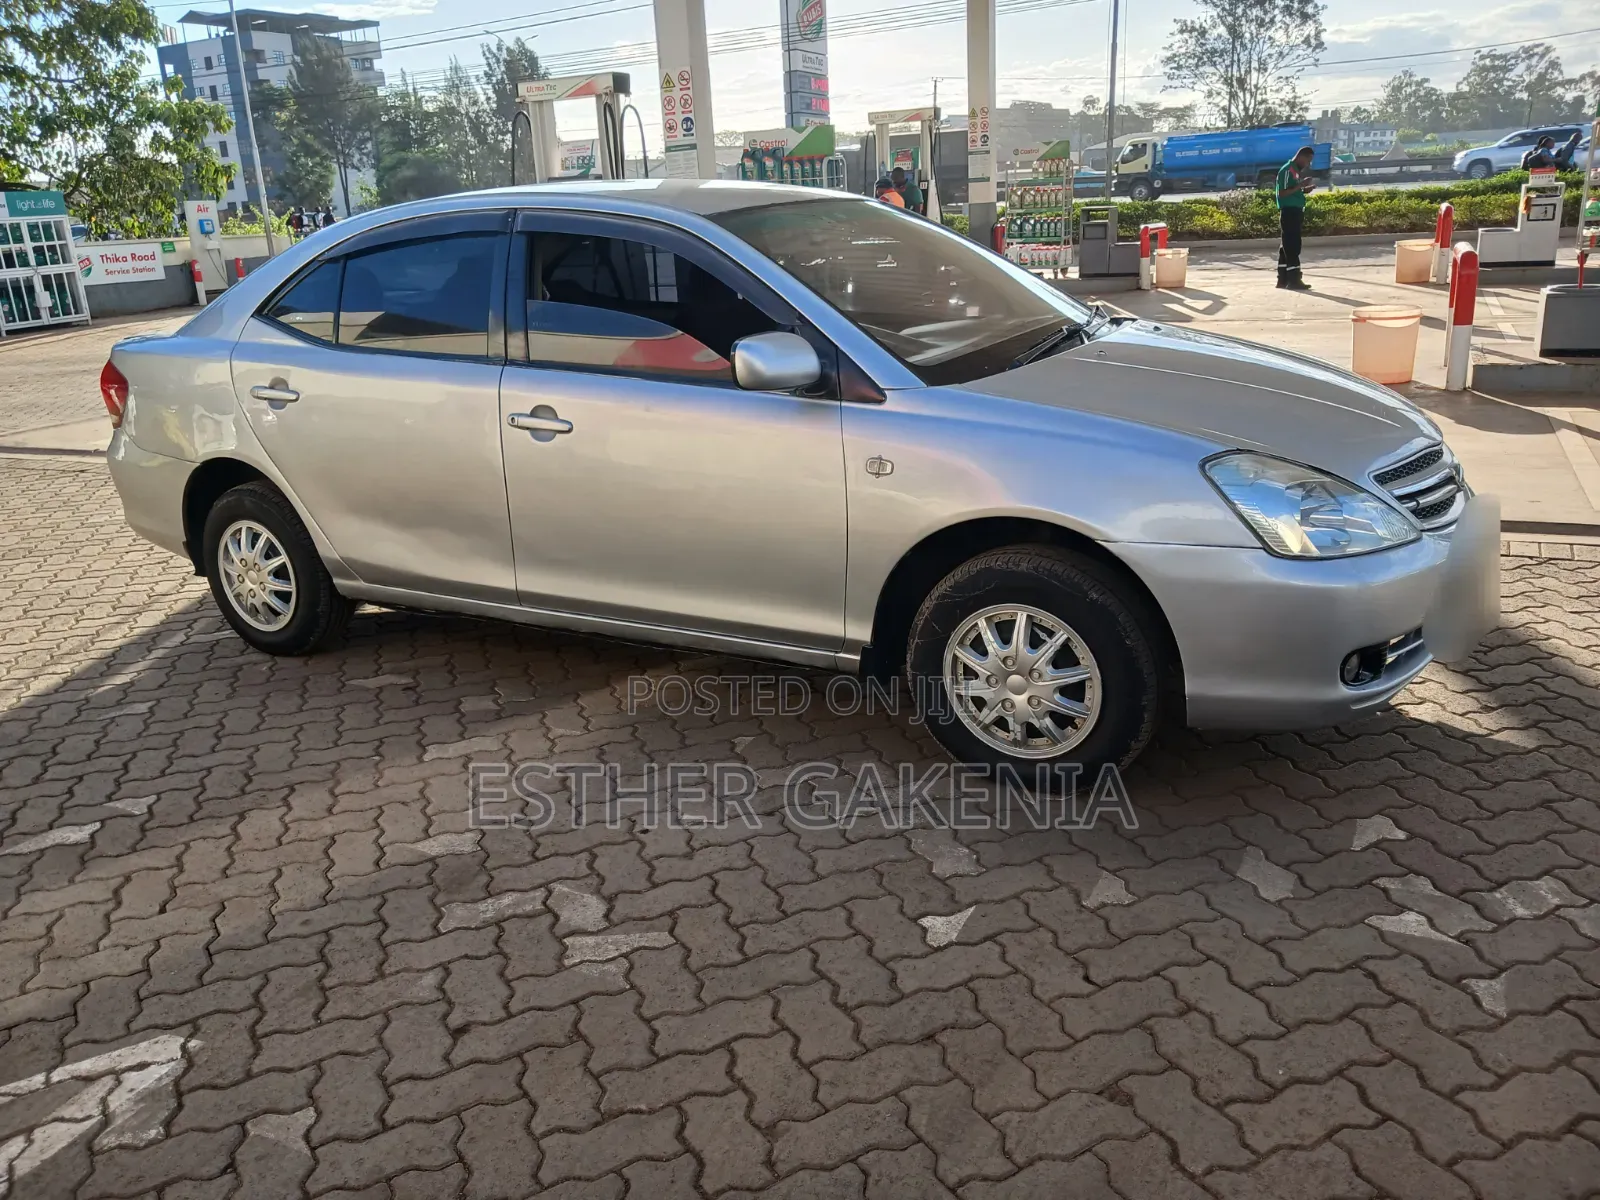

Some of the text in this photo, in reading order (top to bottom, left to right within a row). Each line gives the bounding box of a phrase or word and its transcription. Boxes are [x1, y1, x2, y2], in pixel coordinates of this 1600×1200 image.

[759, 139, 788, 148] Castrol
[196, 204, 209, 213] Air
[99, 251, 157, 264] Thika Road
[105, 265, 157, 276] Service Station
